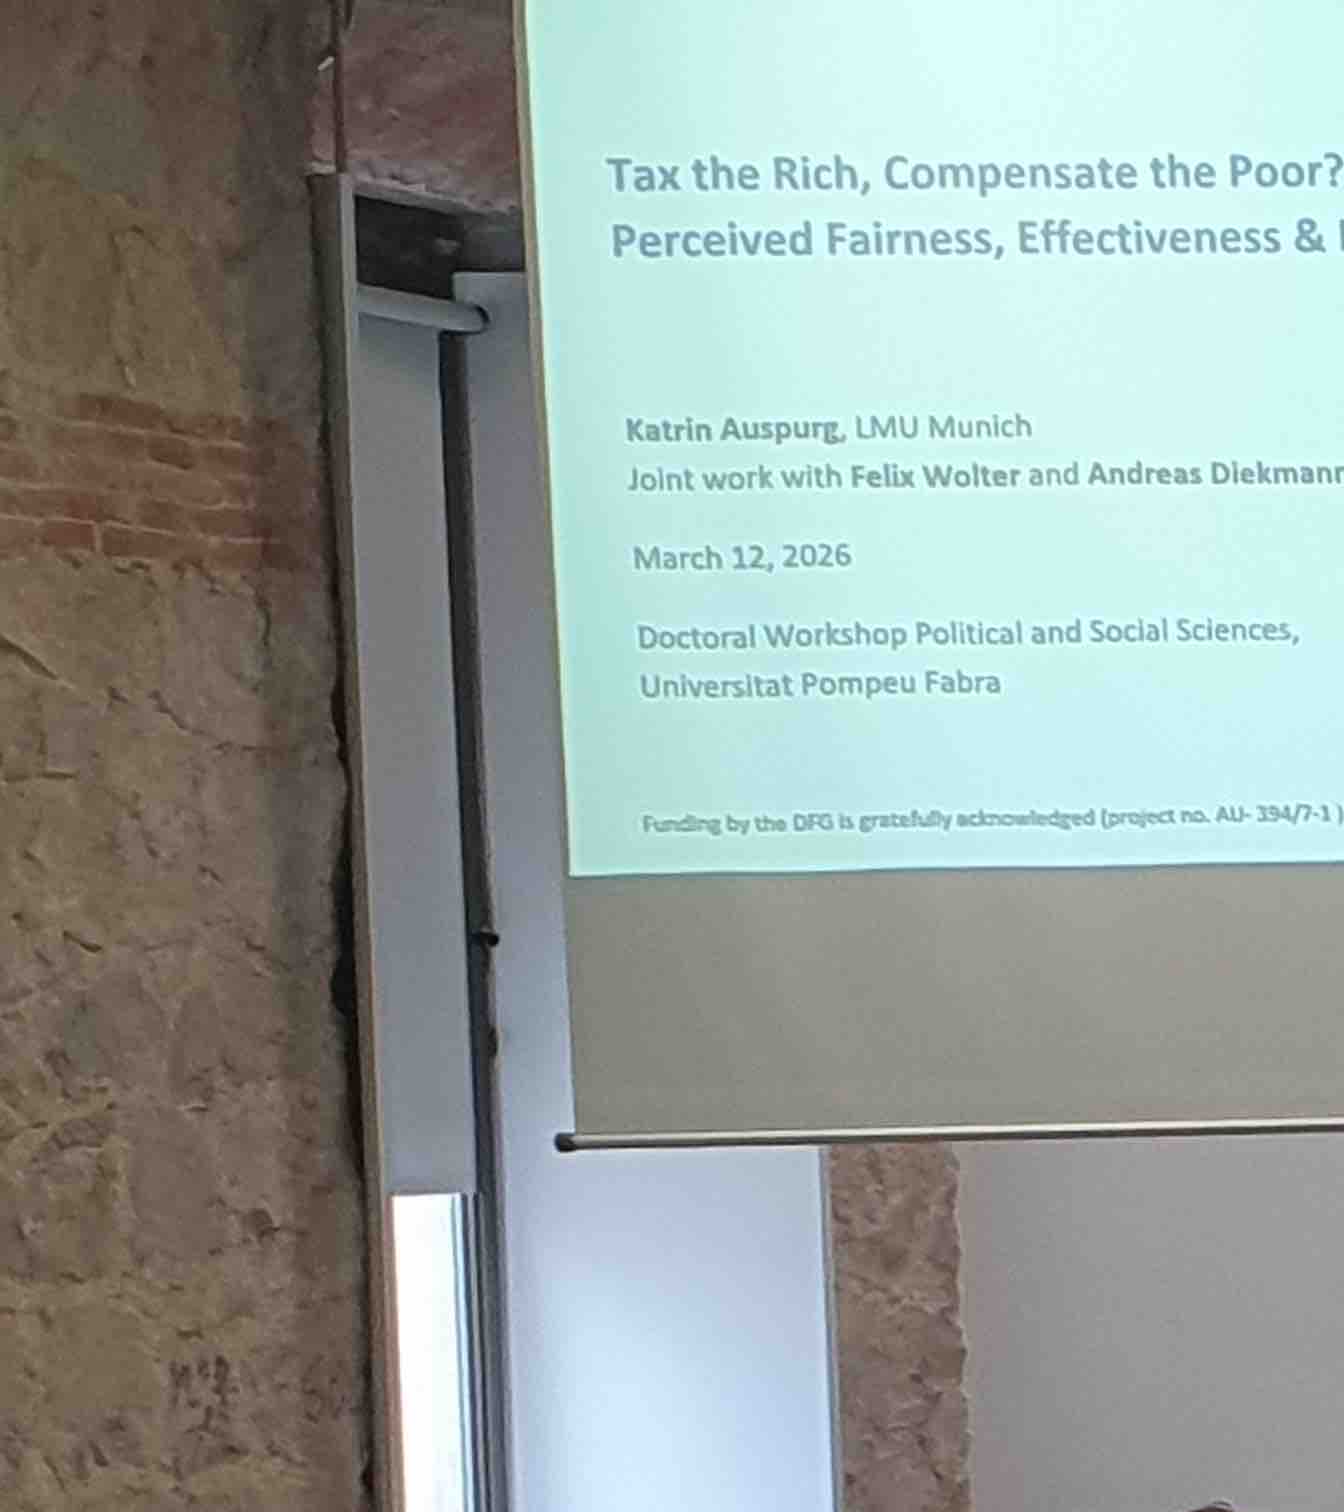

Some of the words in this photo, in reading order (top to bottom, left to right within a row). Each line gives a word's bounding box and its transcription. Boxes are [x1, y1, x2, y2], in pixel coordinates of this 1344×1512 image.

[604, 157, 682, 193] Tax
[690, 154, 761, 193] the
[772, 154, 871, 197] Rich,
[884, 154, 1138, 198] Compensate
[1149, 152, 1217, 189] the
[1229, 151, 1344, 188] Poor?
[612, 220, 813, 259] Perceived
[826, 220, 1004, 260] Fairness,
[1018, 218, 1281, 256] Effectiveness
[1294, 217, 1327, 254] &
[625, 416, 713, 443] Katrin
[855, 415, 919, 440] LMU
[928, 412, 1033, 439] Munich
[627, 466, 696, 492] Joint
[701, 463, 775, 491] work
[780, 463, 843, 489] with
[850, 463, 916, 489] Felix
[921, 461, 1022, 489] Wolter
[1028, 461, 1080, 487] and
[1087, 460, 1204, 486] Andreas
[633, 544, 724, 571] March
[732, 544, 775, 574] 12,
[782, 543, 852, 569] 2026
[637, 623, 757, 651] Doctoral
[762, 620, 908, 651] Workshop
[915, 619, 1023, 646] Political
[1031, 618, 1082, 645] and
[1089, 617, 1169, 643] Social
[1175, 617, 1300, 645] Sciences,
[639, 673, 795, 699] Universitat
[801, 671, 916, 700] Pompeu
[924, 668, 1001, 694] Fabra
[642, 813, 723, 837] Funding
[725, 813, 751, 836] by
[753, 815, 788, 833] the
[792, 812, 835, 833] DFG
[838, 813, 854, 831] is
[858, 809, 953, 834] gratefully
[956, 807, 1096, 831] acknowledged
[1100, 807, 1177, 830] (project
[1255, 803, 1331, 825] 394/7-1
